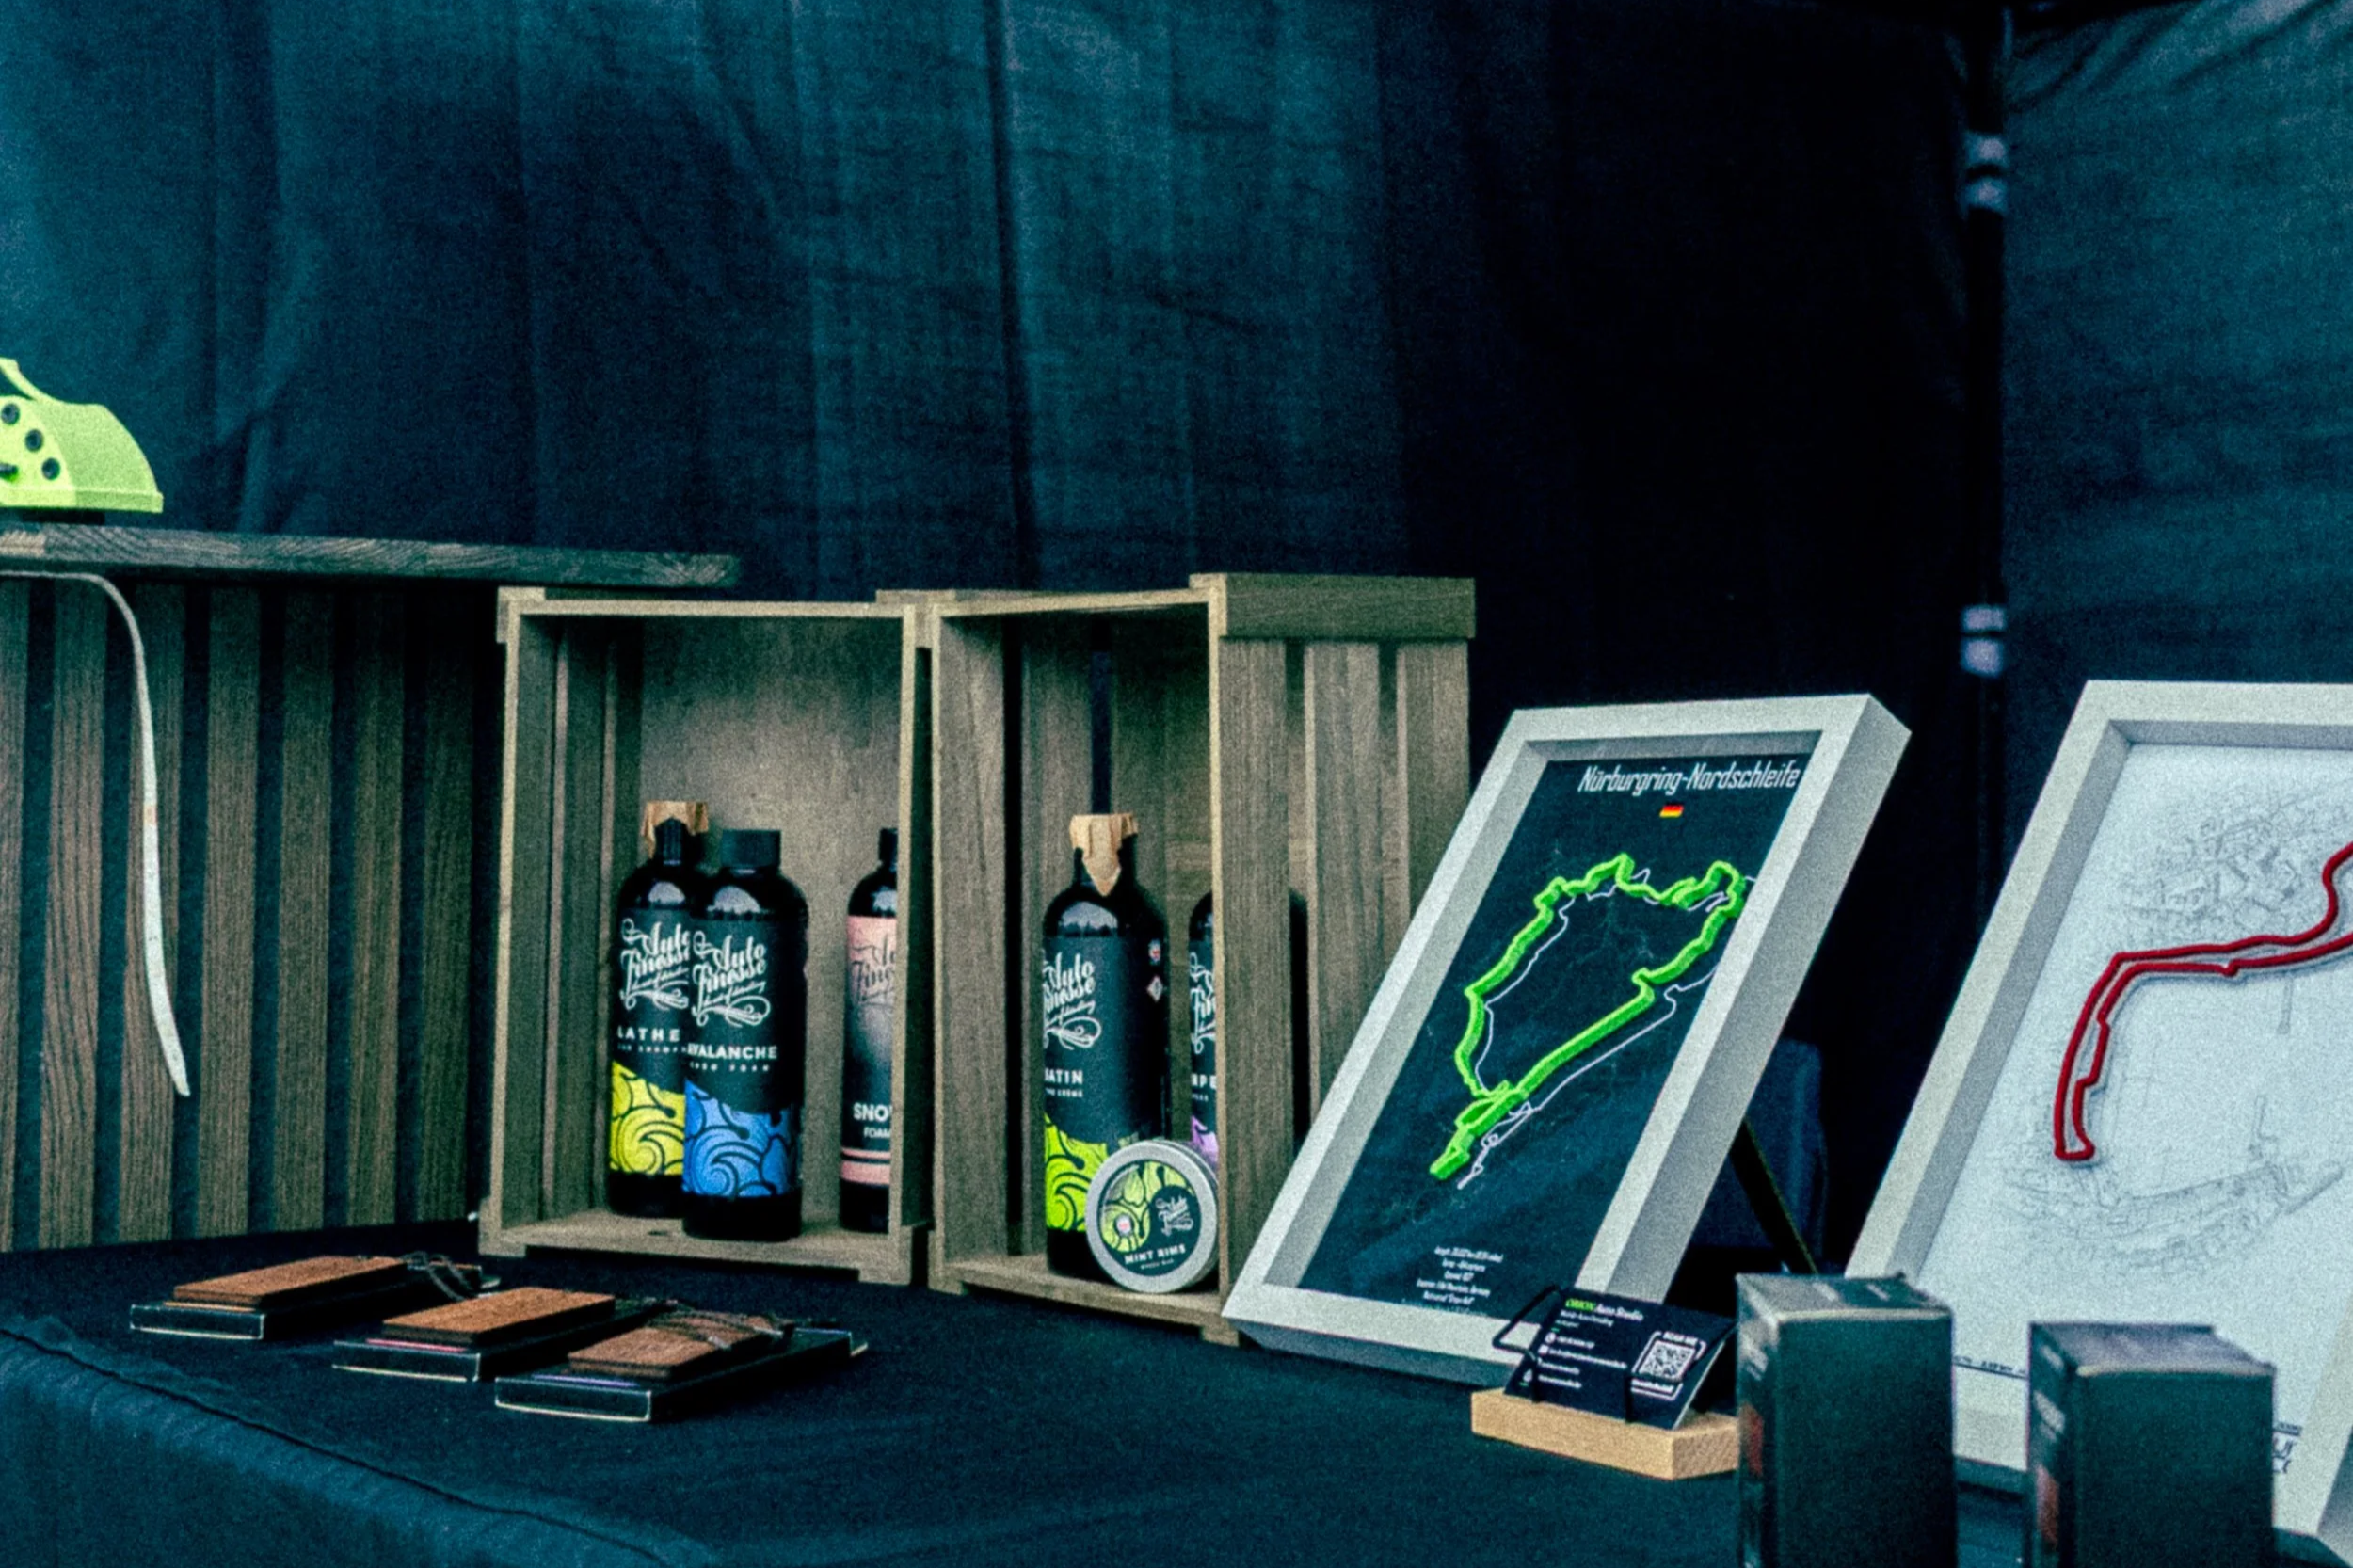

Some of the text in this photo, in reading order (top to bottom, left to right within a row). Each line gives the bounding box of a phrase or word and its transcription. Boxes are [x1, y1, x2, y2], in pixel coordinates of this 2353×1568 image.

[1577, 760, 1801, 796] Nürburgring-Nordschleife
[853, 1102, 893, 1122] SNO
[1125, 1250, 1154, 1265] MINT
